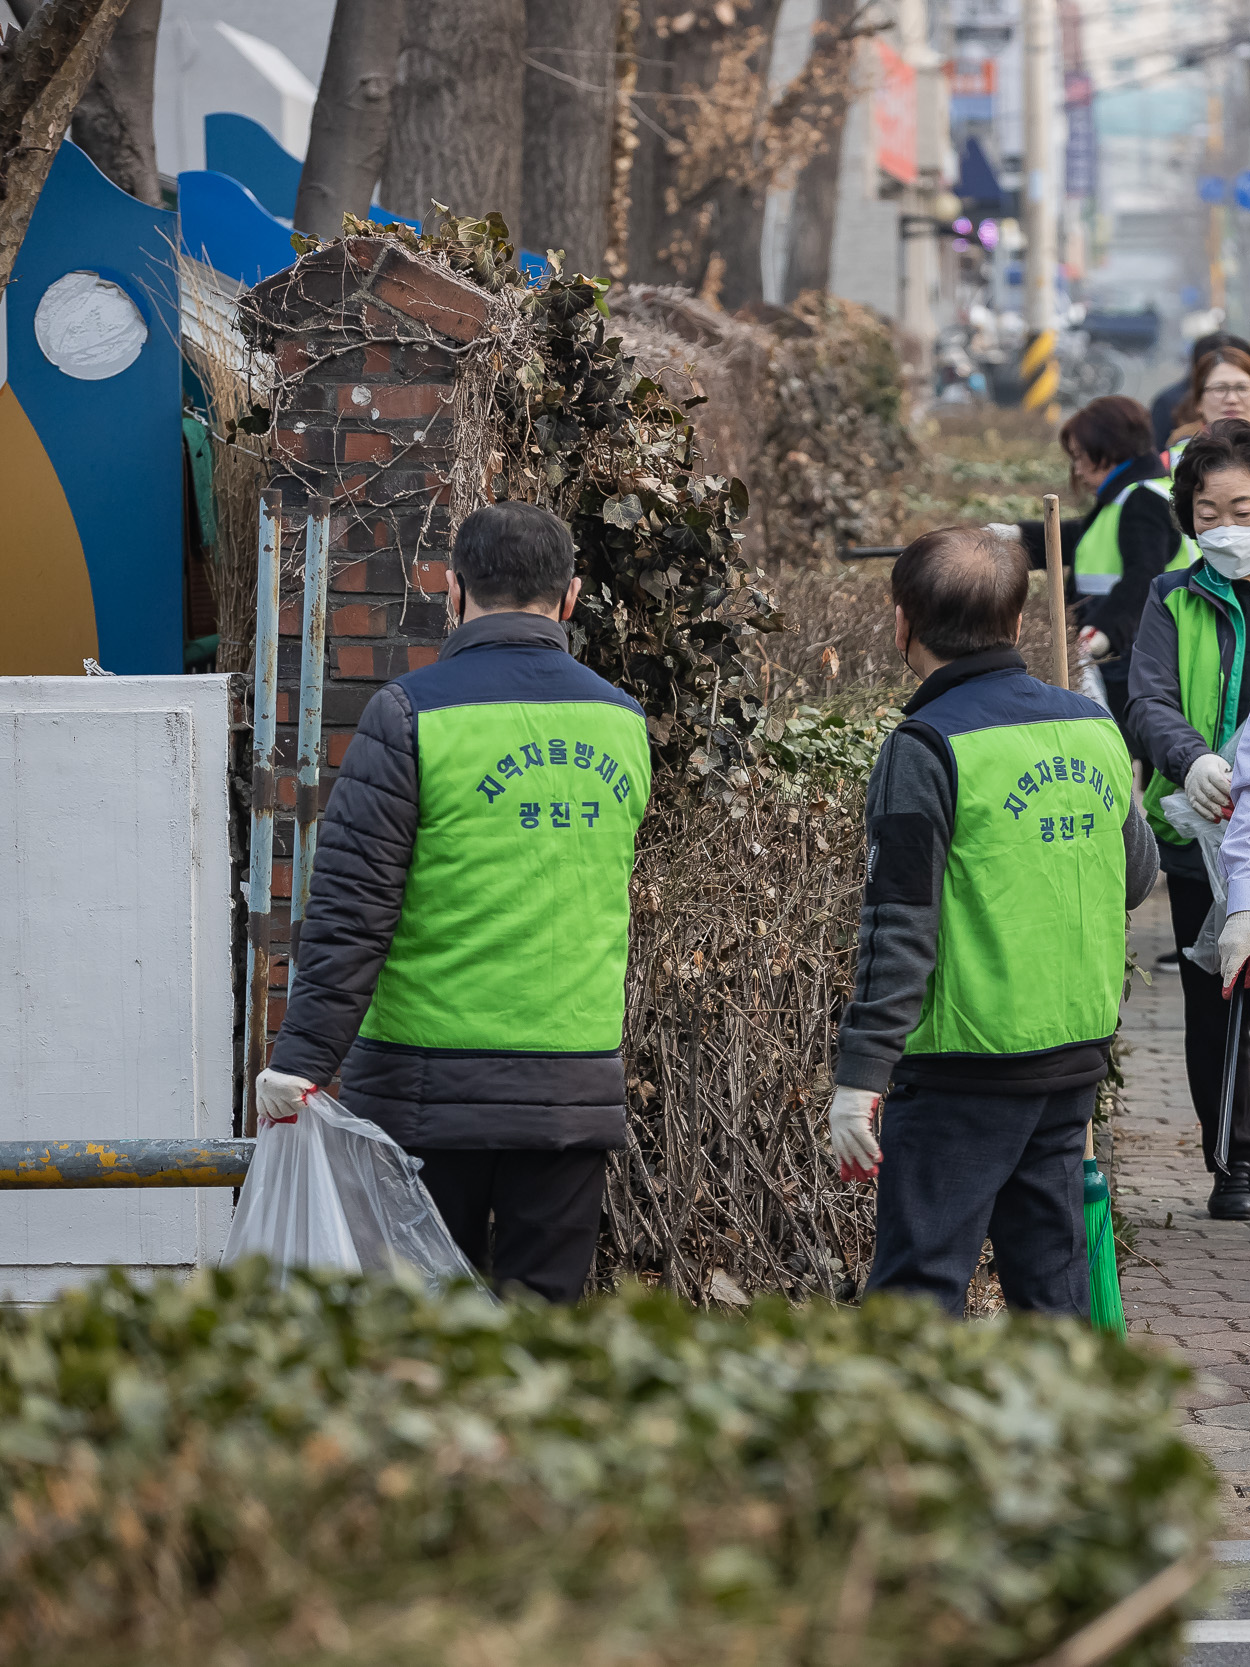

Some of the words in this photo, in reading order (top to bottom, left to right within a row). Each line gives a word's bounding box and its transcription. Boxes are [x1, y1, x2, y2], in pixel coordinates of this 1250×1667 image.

[476, 738, 630, 804] 지역자율방재단
[1003, 756, 1114, 820] 지역자율방재단
[519, 801, 600, 829] 광진구
[1039, 813, 1095, 843] 광진구
